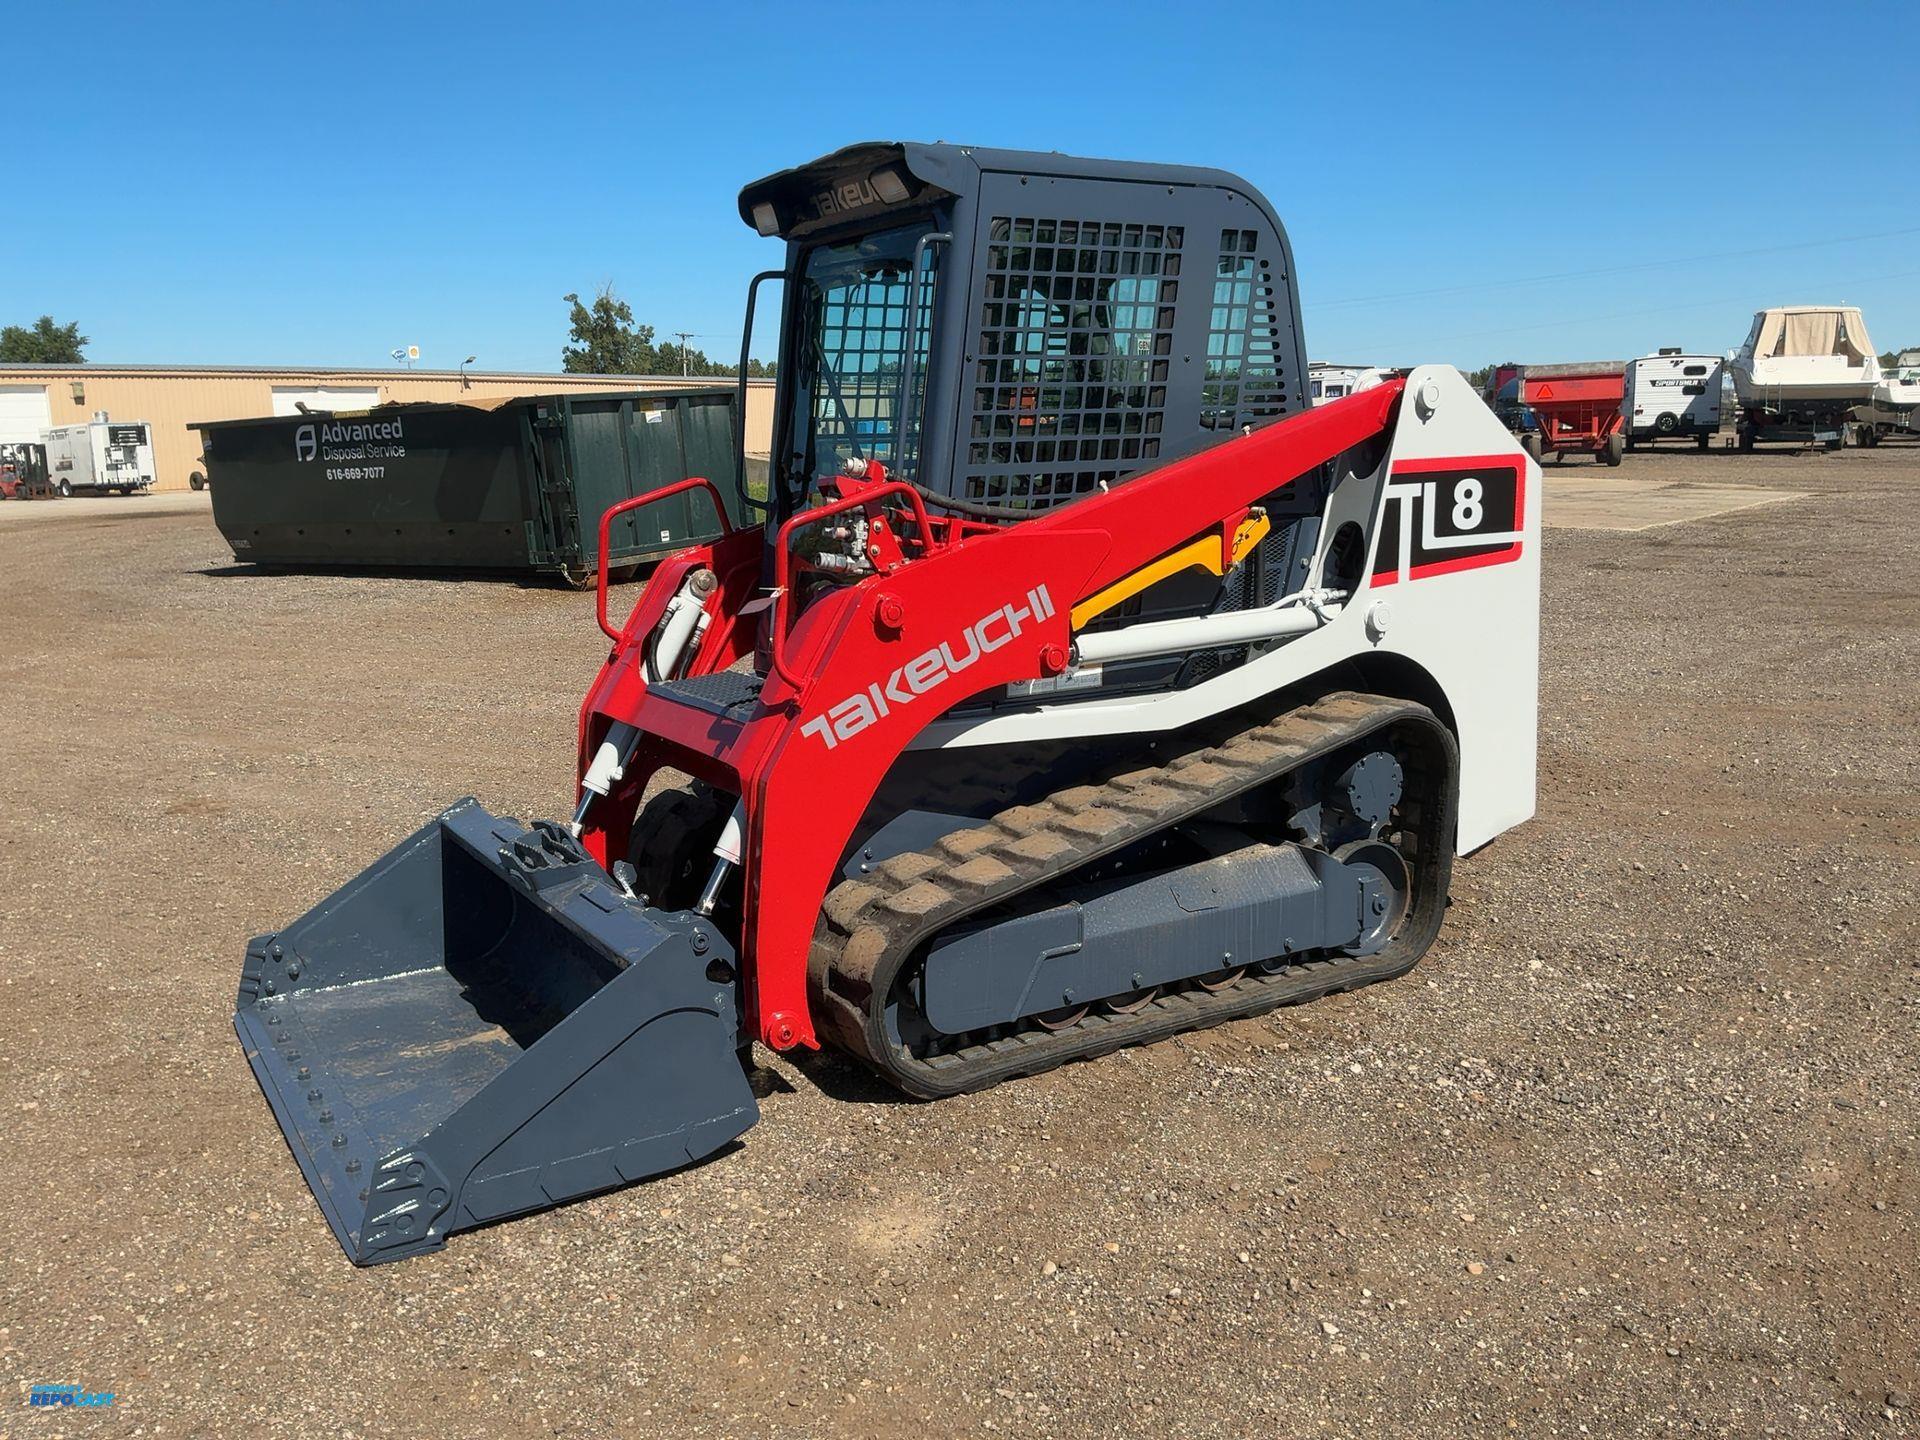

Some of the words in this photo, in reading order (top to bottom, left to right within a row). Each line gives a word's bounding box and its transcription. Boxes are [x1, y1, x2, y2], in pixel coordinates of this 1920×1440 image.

[321, 416, 403, 443] Advanced
[322, 444, 366, 462] Disposal
[367, 442, 406, 458] Service
[326, 466, 385, 480] 616-669-7077
